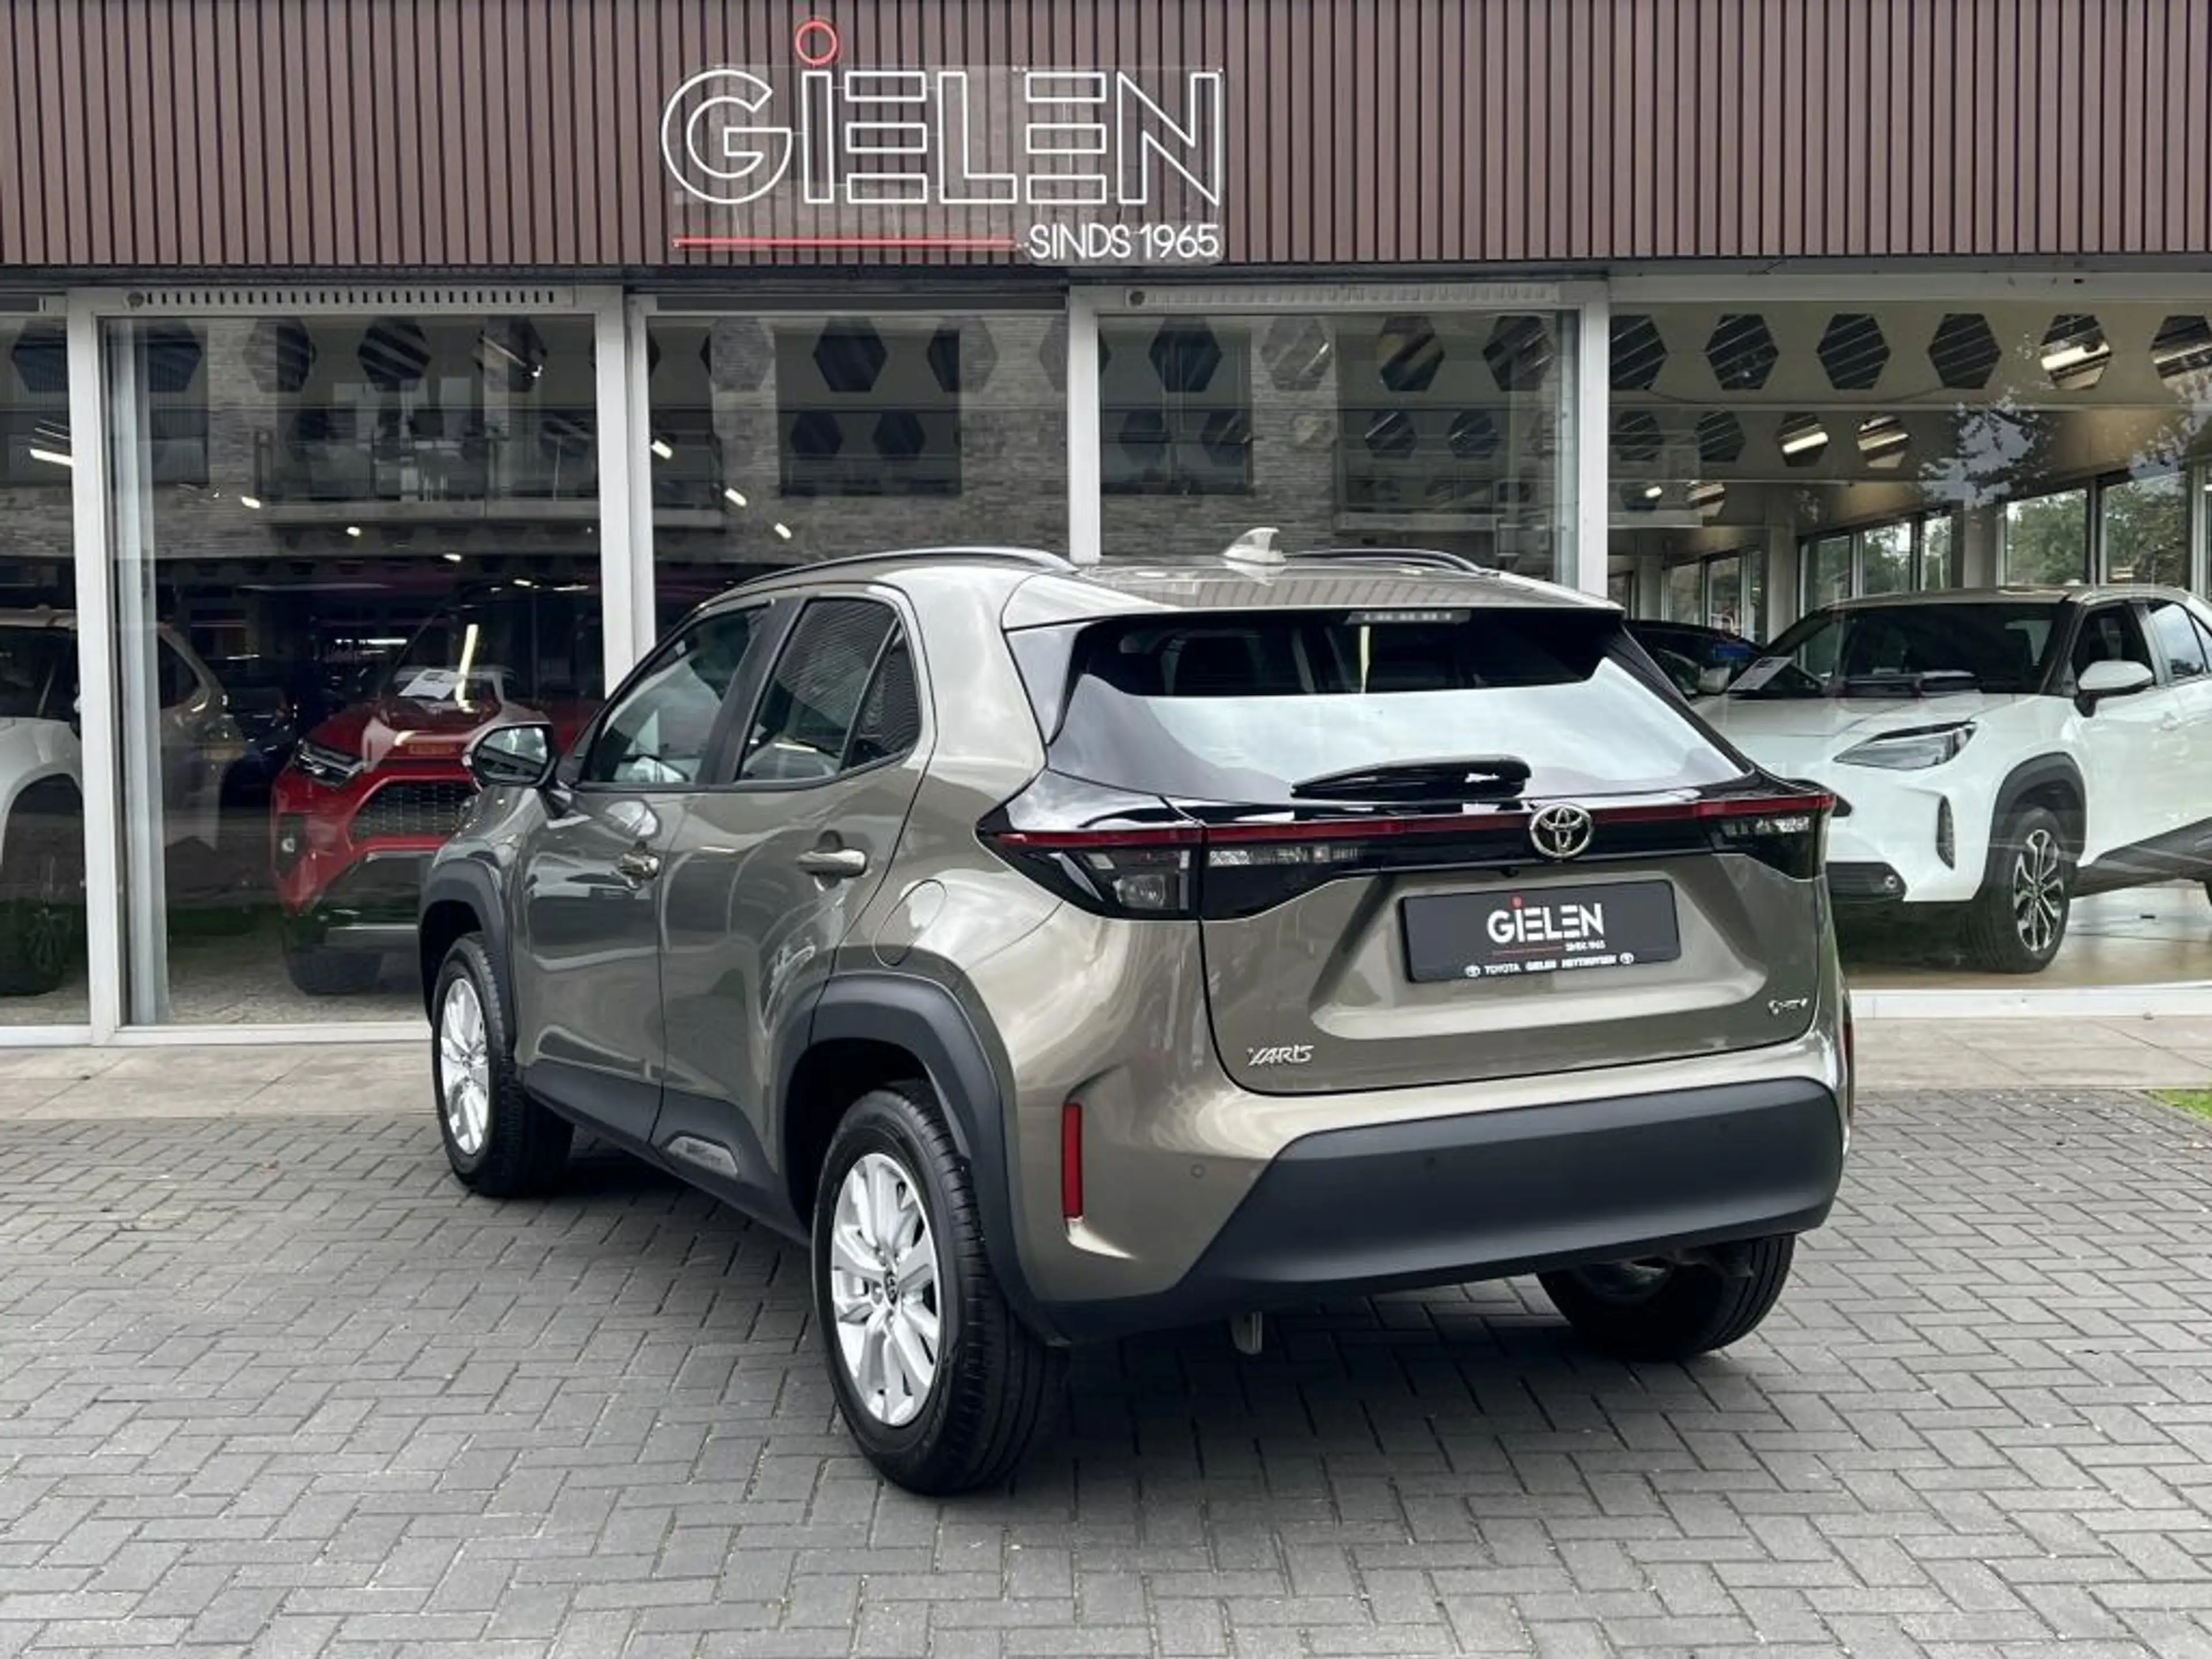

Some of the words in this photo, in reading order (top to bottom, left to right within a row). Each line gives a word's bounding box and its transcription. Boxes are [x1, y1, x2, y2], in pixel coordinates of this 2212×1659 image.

[1029, 223, 1131, 260] SINDS
[1143, 222, 1219, 260] 1965
[1247, 1044, 1315, 1066] YARIS
